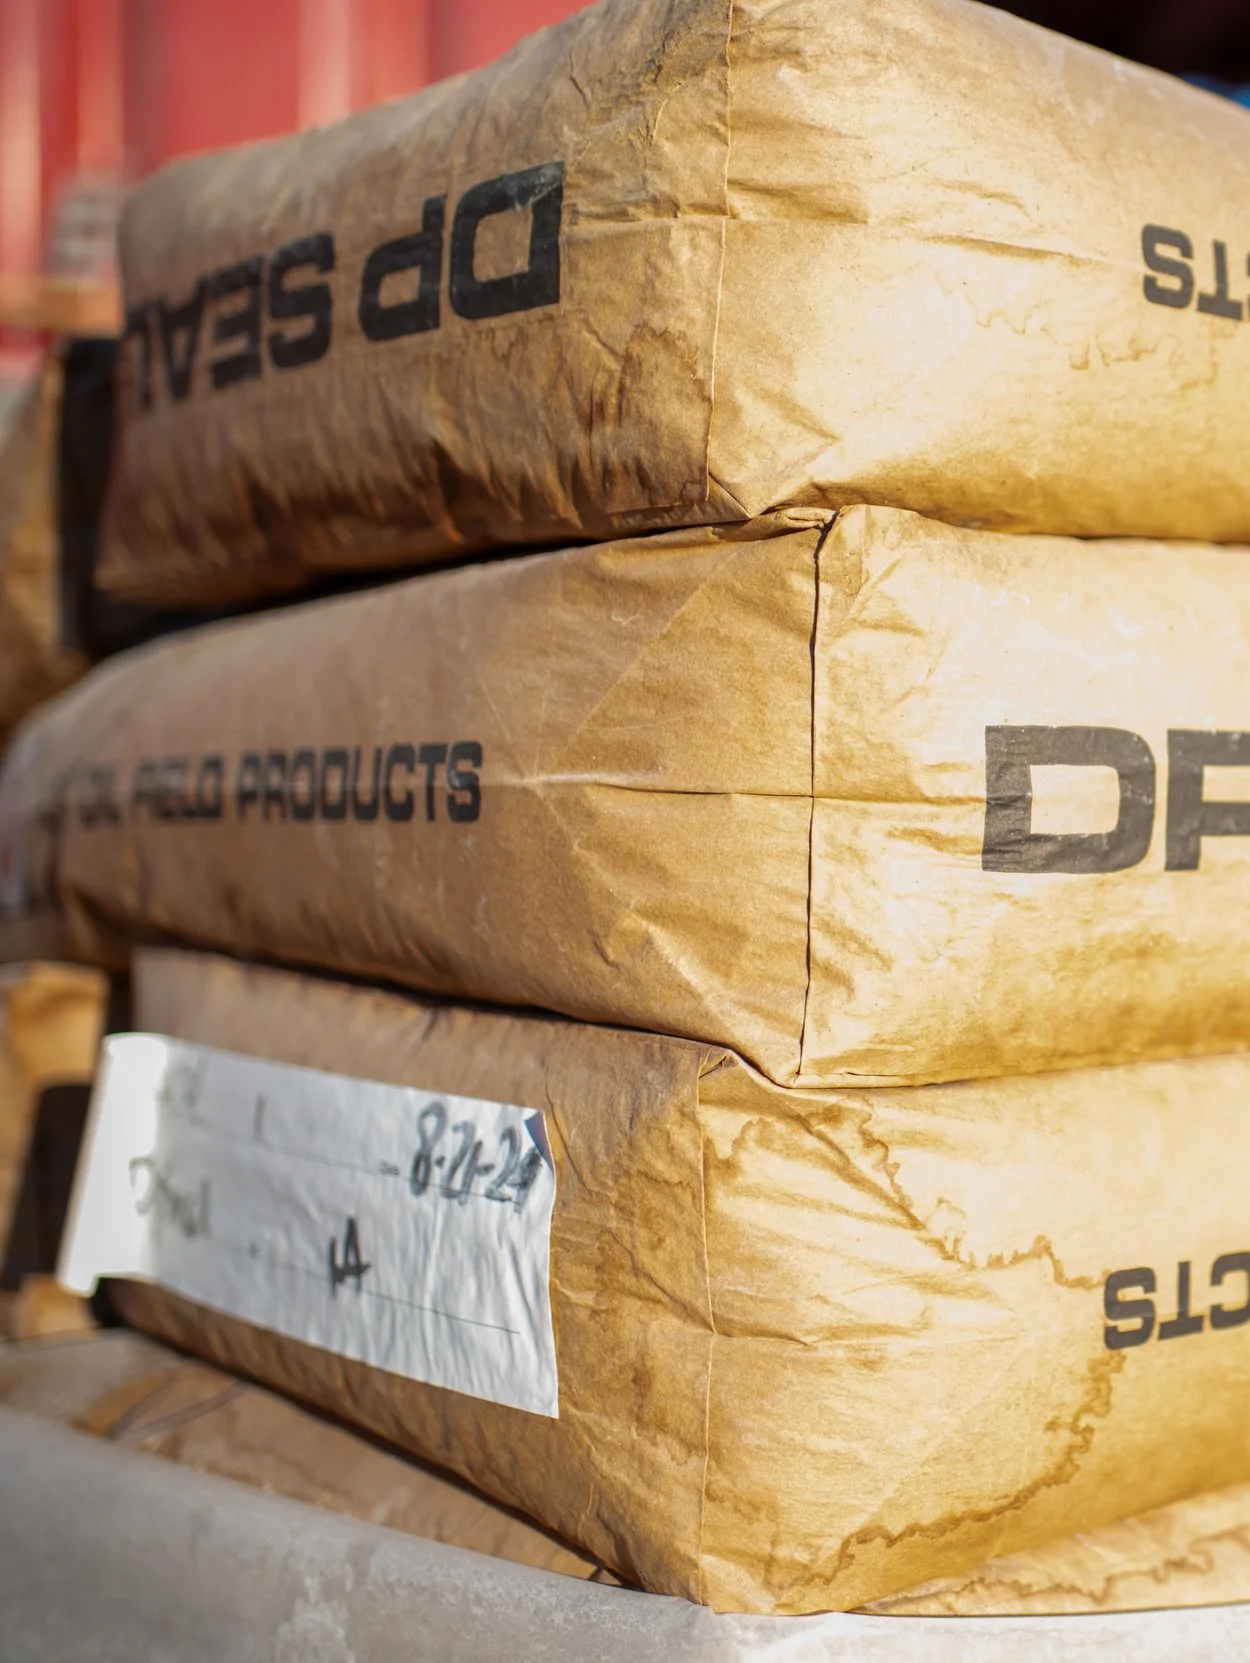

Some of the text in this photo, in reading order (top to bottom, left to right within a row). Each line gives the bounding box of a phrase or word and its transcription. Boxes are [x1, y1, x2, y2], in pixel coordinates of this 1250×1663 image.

[119, 160, 565, 408] DP SEAL
[235, 741, 483, 824] PRODUCTS
